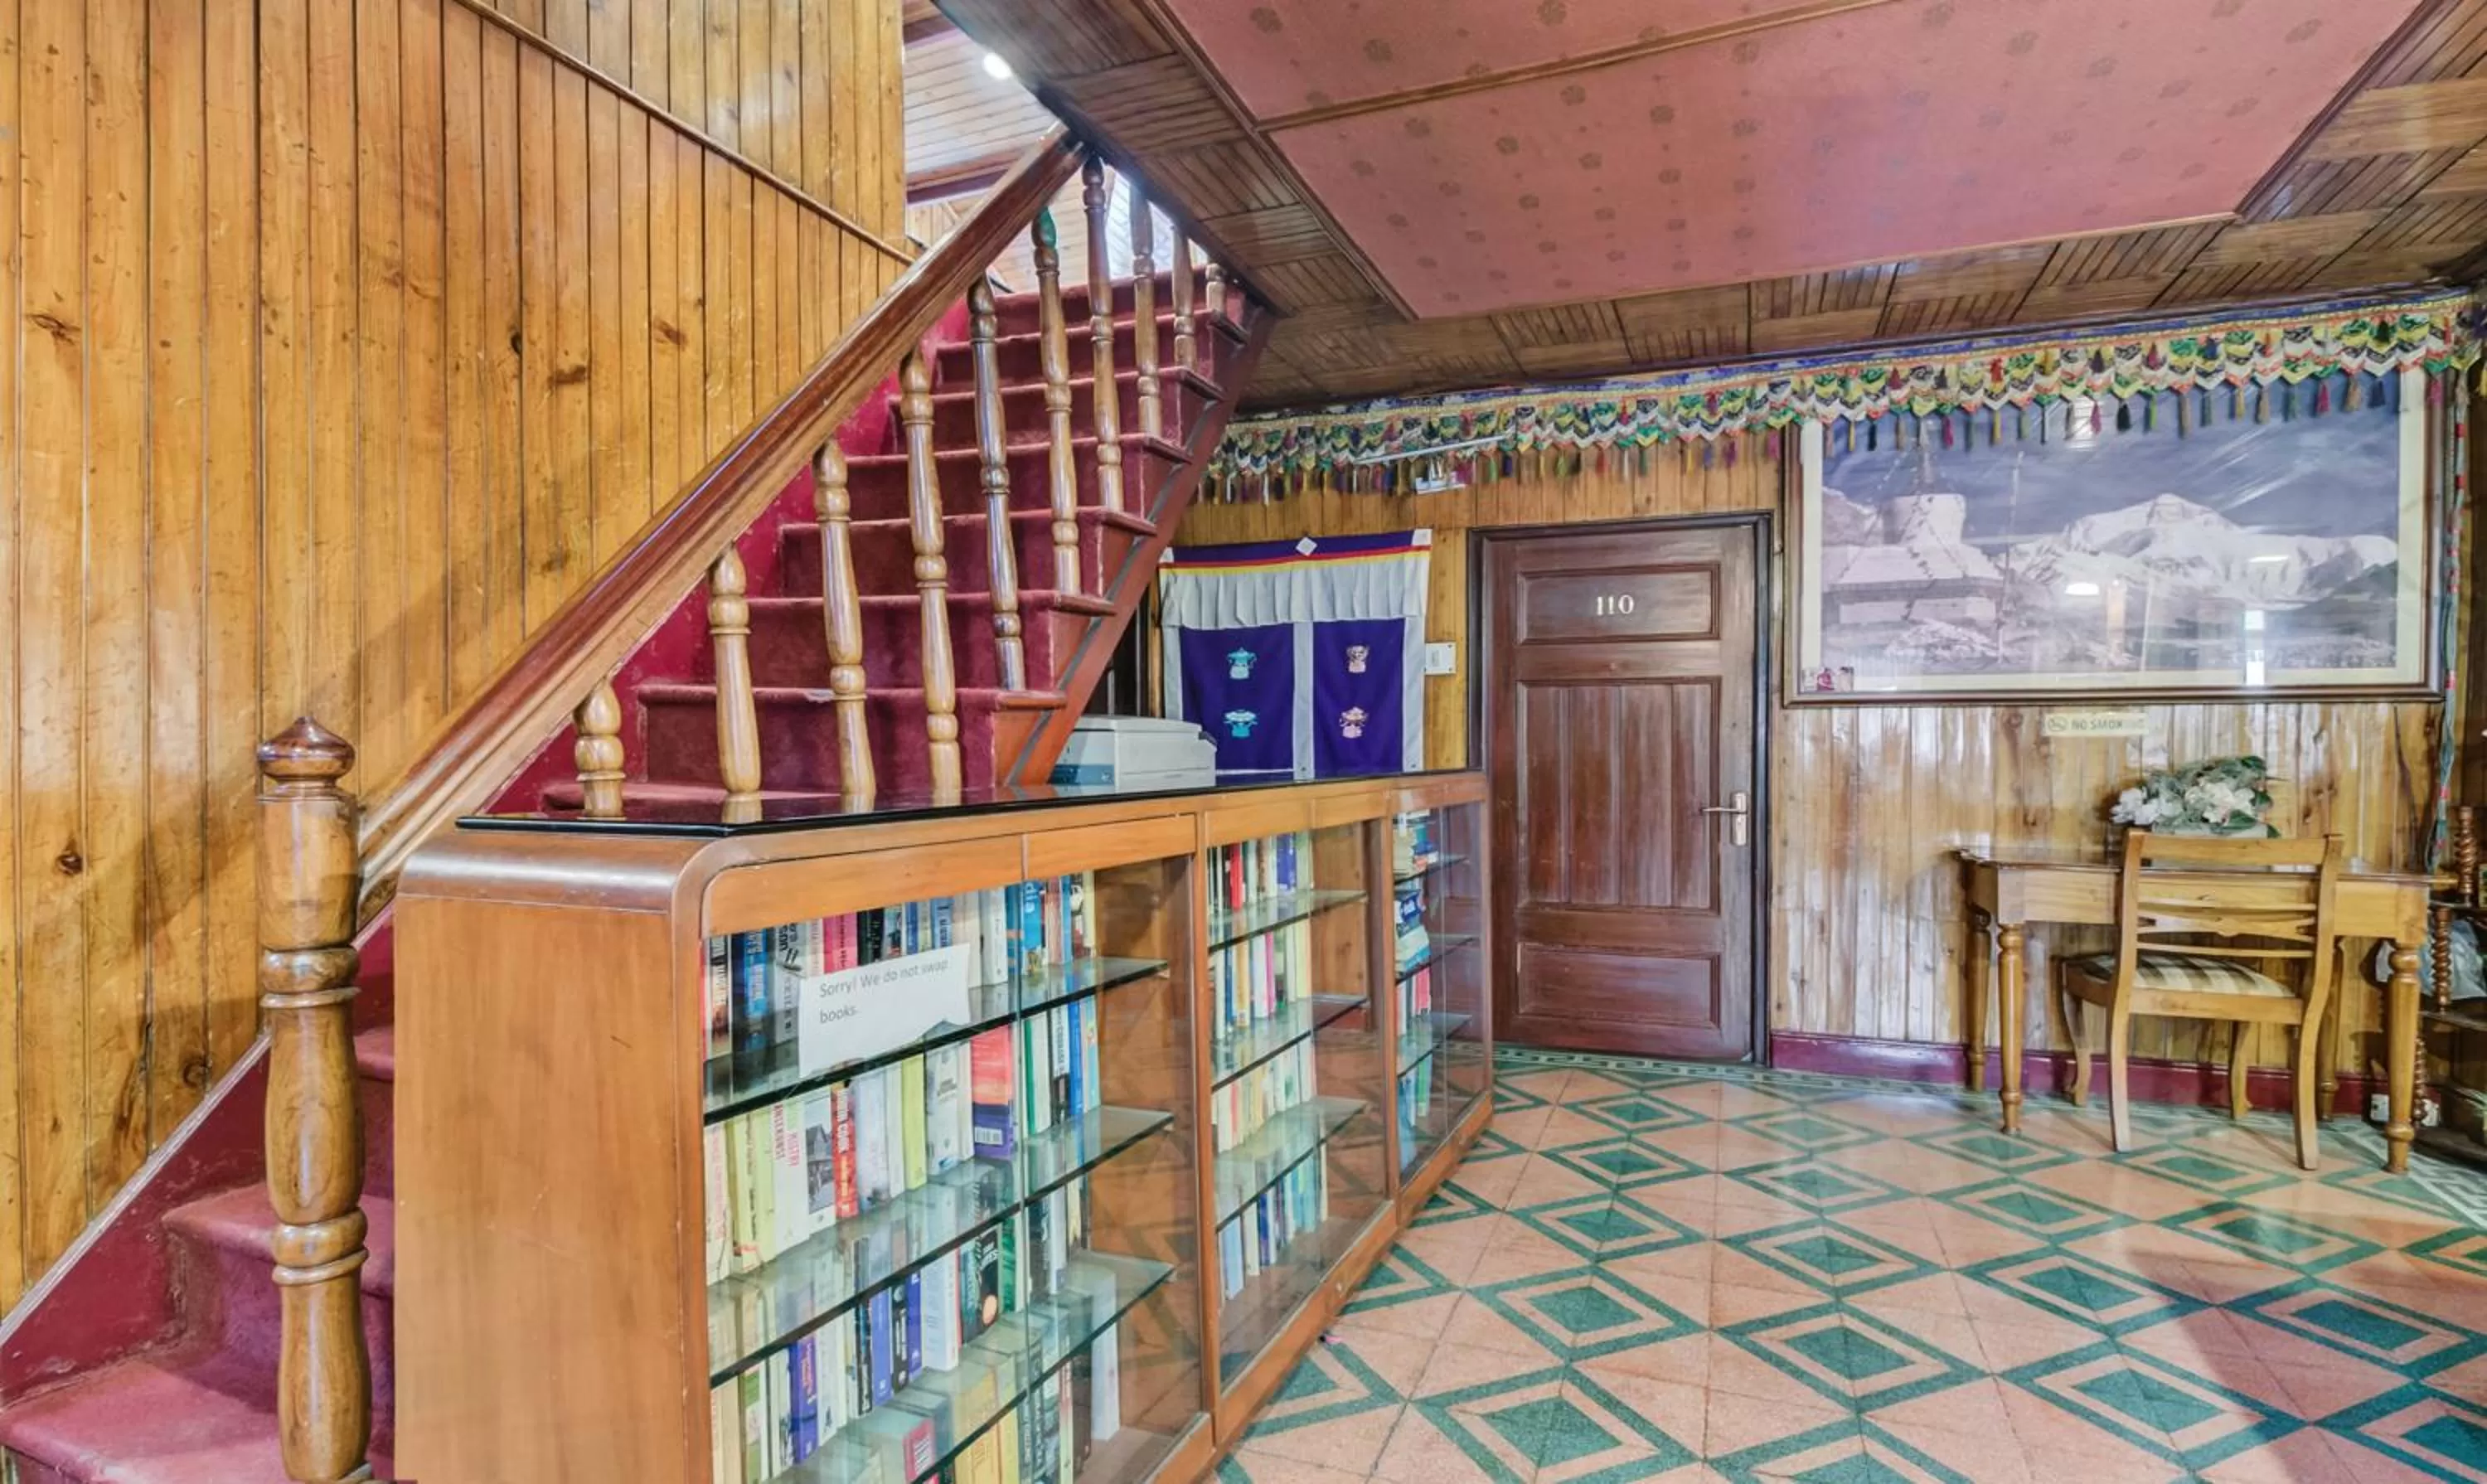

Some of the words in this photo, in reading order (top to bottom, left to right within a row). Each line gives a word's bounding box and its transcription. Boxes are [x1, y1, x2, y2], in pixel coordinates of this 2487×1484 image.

[1597, 594, 1635, 616] 110
[819, 977, 857, 998] Sorry!
[860, 973, 880, 989] We
[883, 968, 899, 982] do
[900, 963, 919, 977] not
[920, 958, 950, 976] swap
